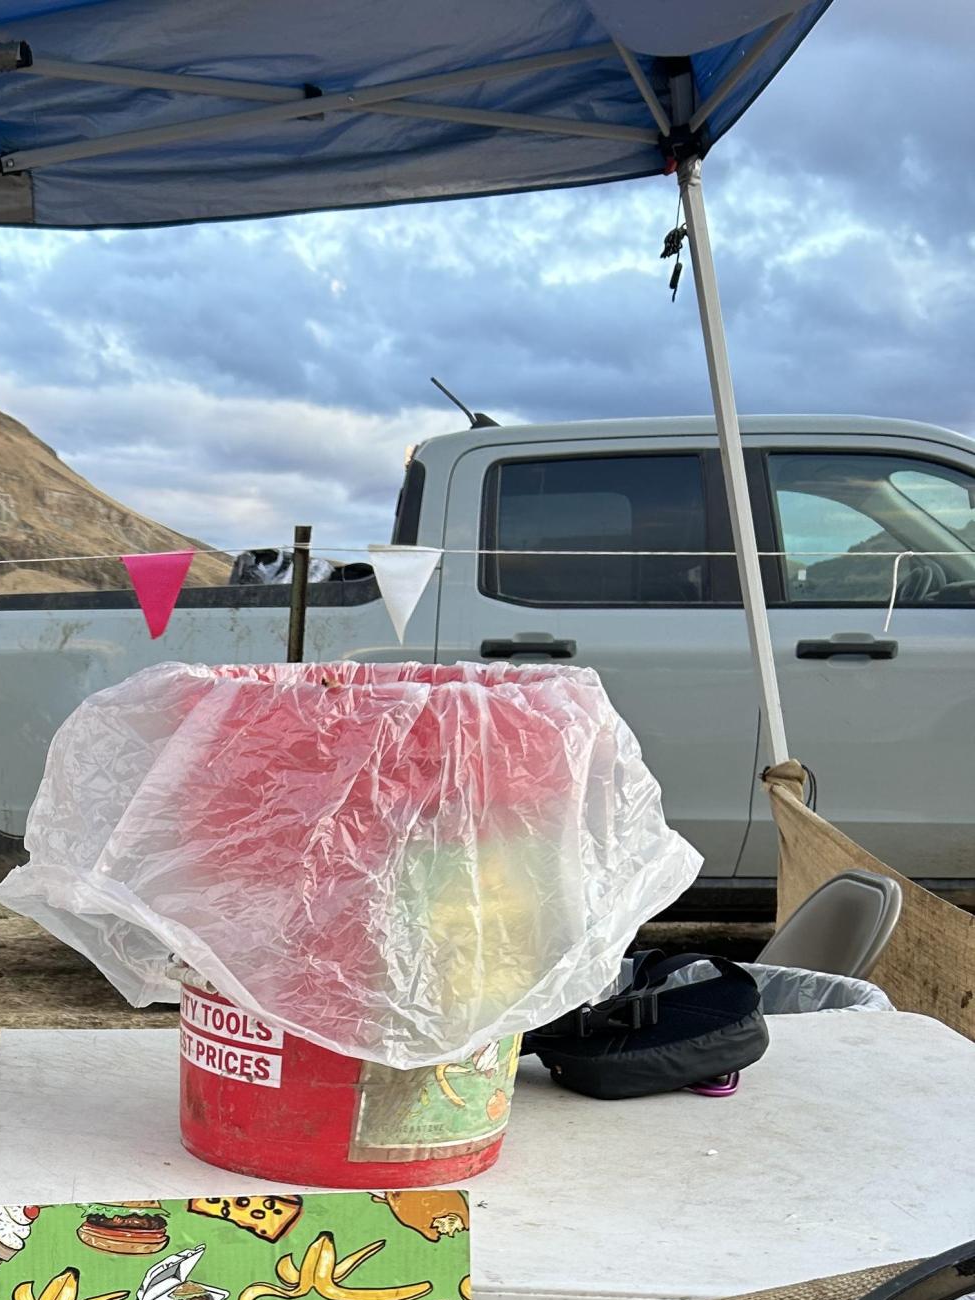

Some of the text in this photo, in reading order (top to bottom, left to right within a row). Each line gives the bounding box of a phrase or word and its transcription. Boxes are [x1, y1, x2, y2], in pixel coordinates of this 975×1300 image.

[201, 1003, 273, 1042] TOOLS
[180, 1028, 271, 1081] ST PRICES
